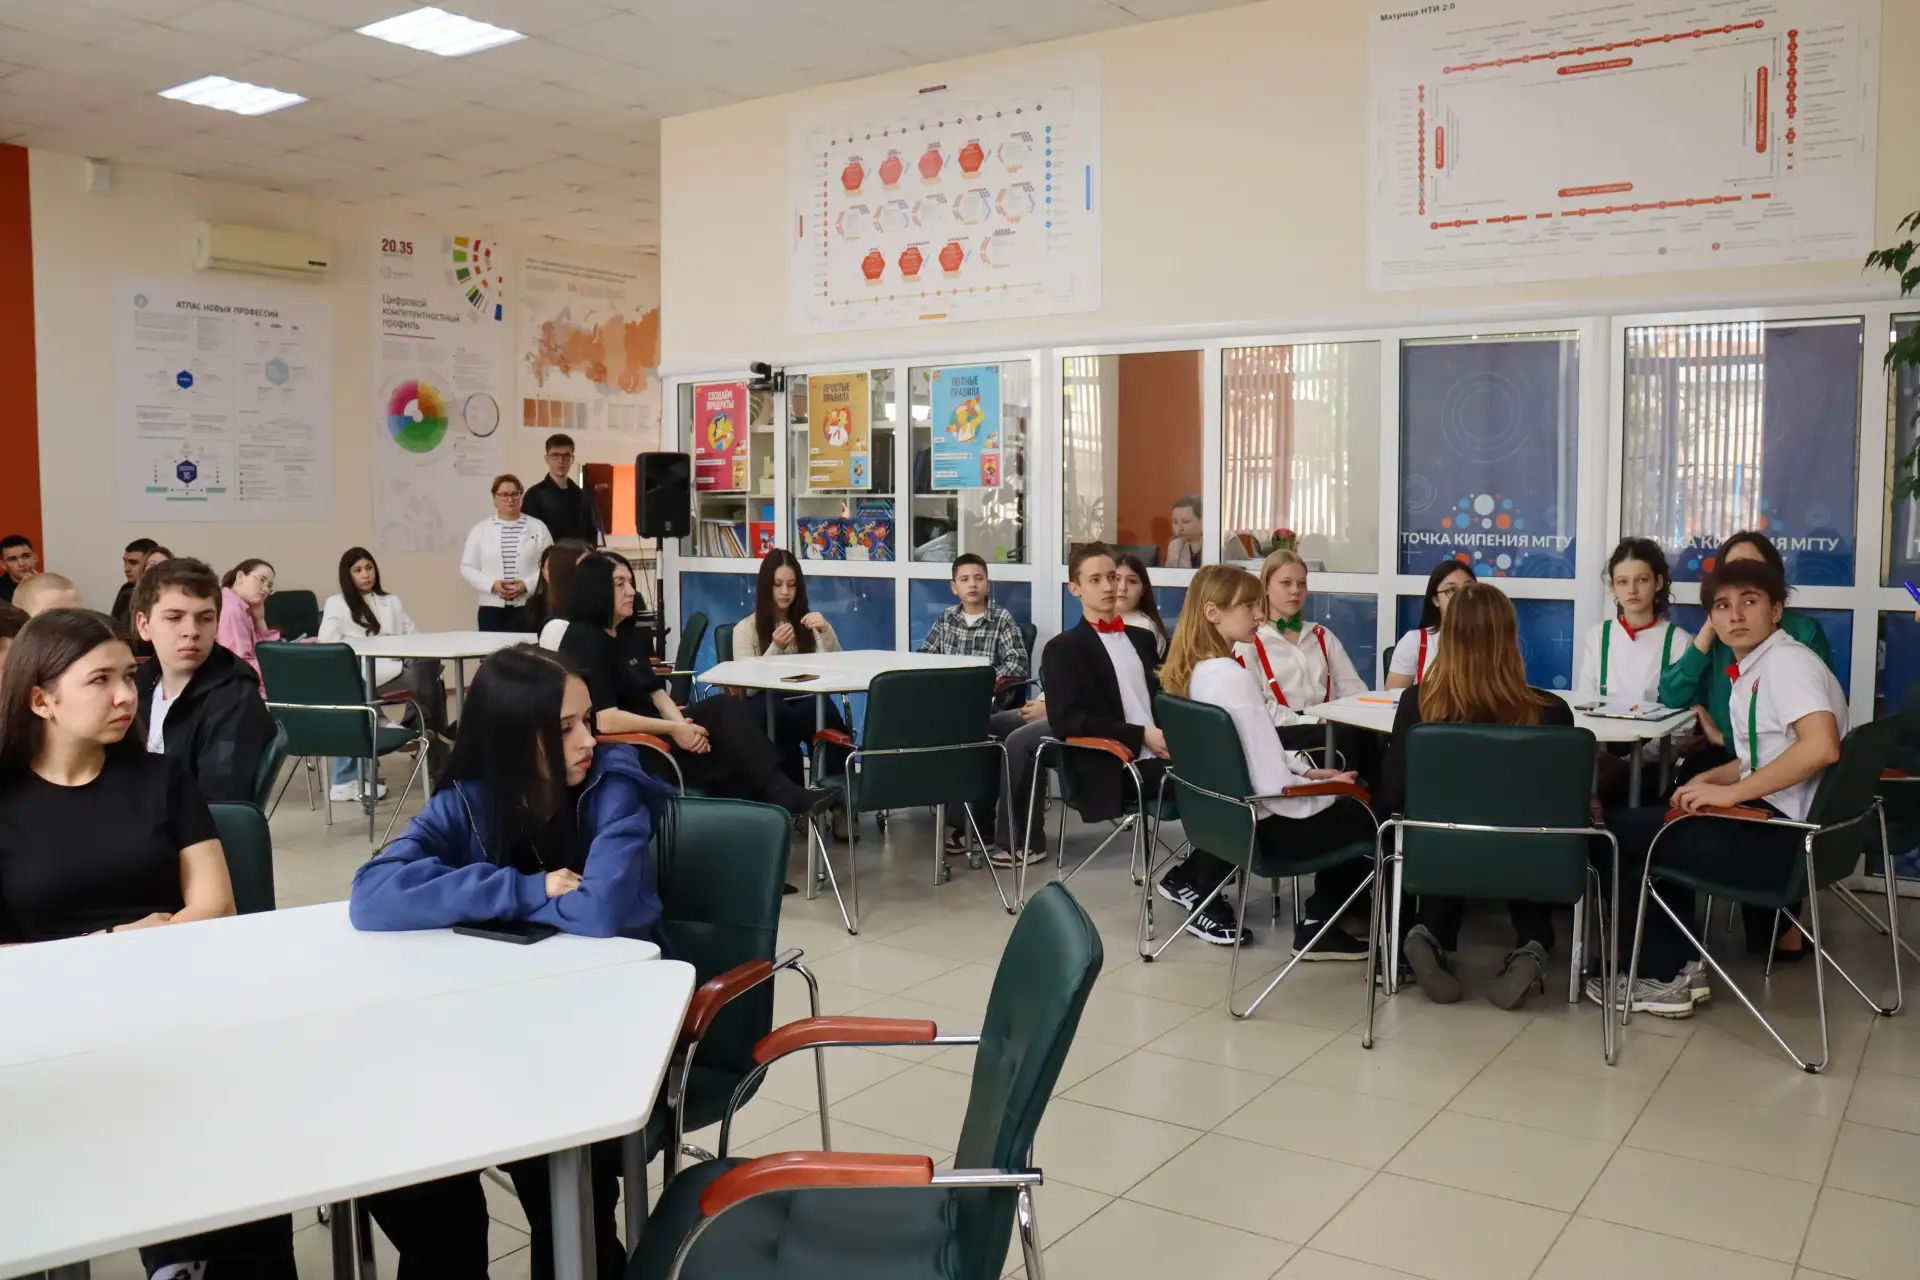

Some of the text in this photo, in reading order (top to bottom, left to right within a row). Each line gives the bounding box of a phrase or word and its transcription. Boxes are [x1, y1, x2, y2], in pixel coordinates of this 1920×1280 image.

[1380, 10, 1418, 21] Матрица
[1421, 5, 1440, 15] НТИ
[382, 238, 413, 255] 20.35
[382, 294, 427, 308] Цифровой
[176, 300, 279, 318] АТЛАС НОВЫХ ПРОФЕССИЙ
[382, 308, 460, 323] компетентностный
[382, 319, 420, 330] профиль
[823, 383, 850, 393] ПРОСТЫЕ
[950, 387, 980, 397] ПРАВИЛА
[823, 392, 850, 402] ПРАВИЛА
[706, 399, 735, 410] ПРОДУКТЫ
[1401, 532, 1573, 549] ТОЧКА КИПЕНИЯ МГТУ
[1791, 537, 1839, 551] МГТУ
